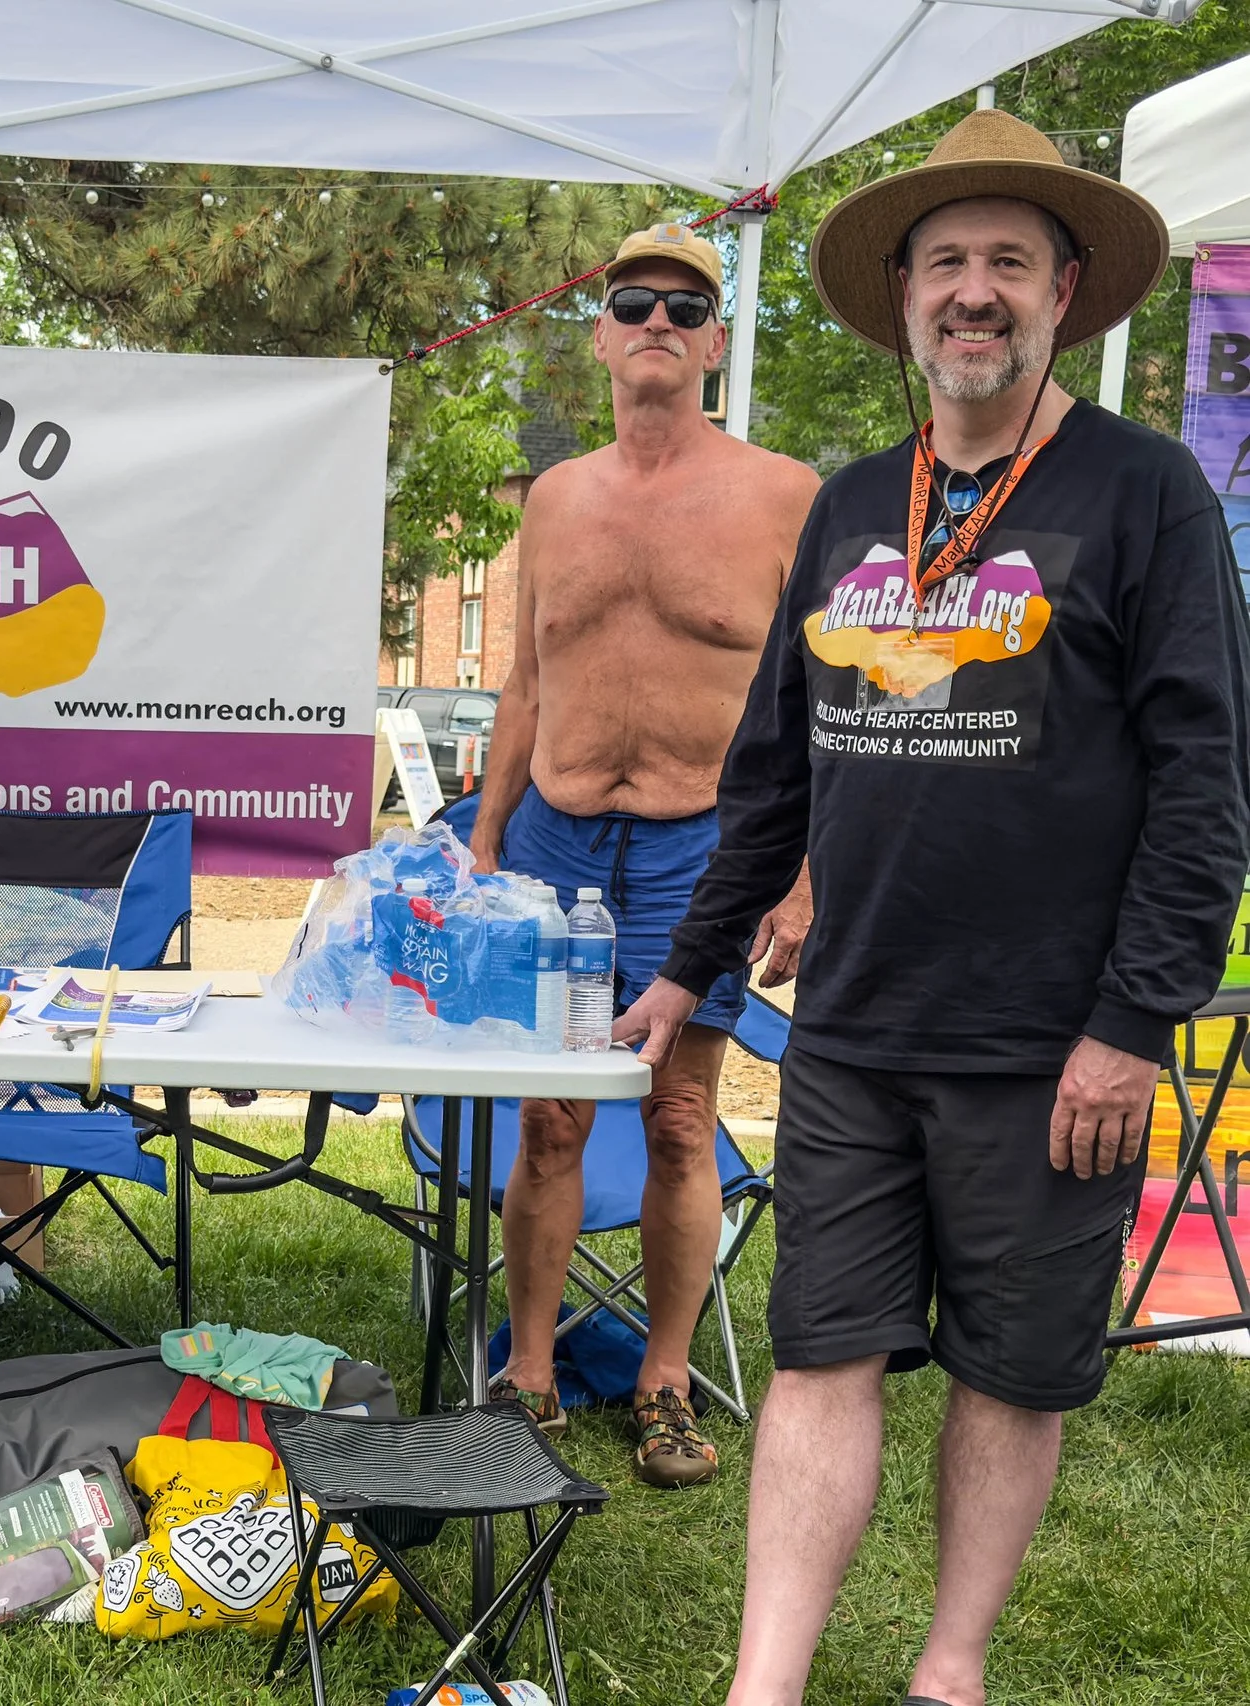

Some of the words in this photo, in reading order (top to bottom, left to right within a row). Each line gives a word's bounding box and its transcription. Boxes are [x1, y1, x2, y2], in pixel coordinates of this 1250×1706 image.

[54, 697, 347, 728] www.manreach.org
[865, 709, 1018, 730] HEART-CENTERED
[892, 737, 903, 755] &
[908, 736, 1021, 758] COMMUNITY
[66, 780, 133, 813] and
[148, 780, 354, 827] Community
[69, 1481, 87, 1523] SUNWALL
[90, 1485, 107, 1519] Coleman
[322, 1563, 354, 1587] JAM
